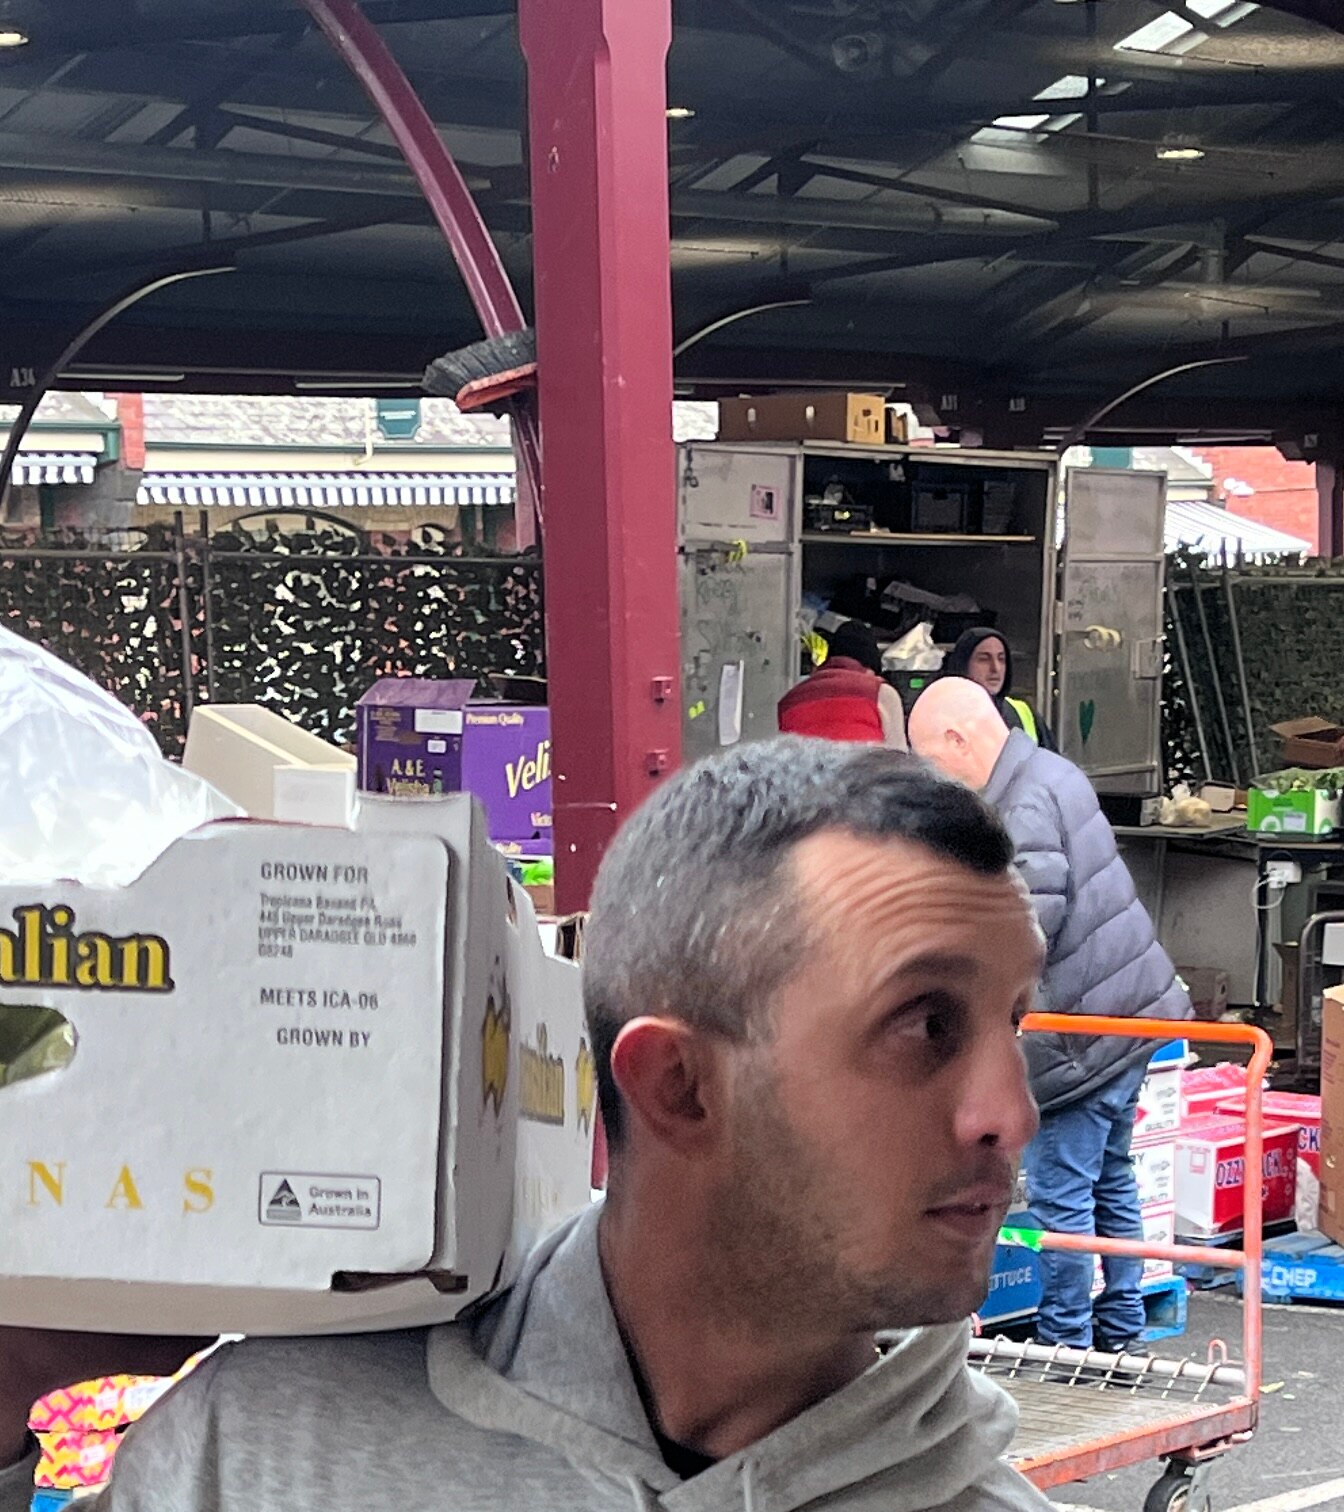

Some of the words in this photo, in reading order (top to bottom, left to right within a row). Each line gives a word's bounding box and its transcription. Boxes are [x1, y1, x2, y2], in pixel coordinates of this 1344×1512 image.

[506, 740, 551, 798] Veli
[260, 862, 329, 882] GROWN
[332, 864, 369, 884] FOR
[260, 987, 317, 1008] MEETS
[276, 1027, 343, 1047] GROWN
[349, 1031, 371, 1048] BY
[1216, 1159, 1246, 1188] OZZ
[308, 1203, 372, 1217] Australia
